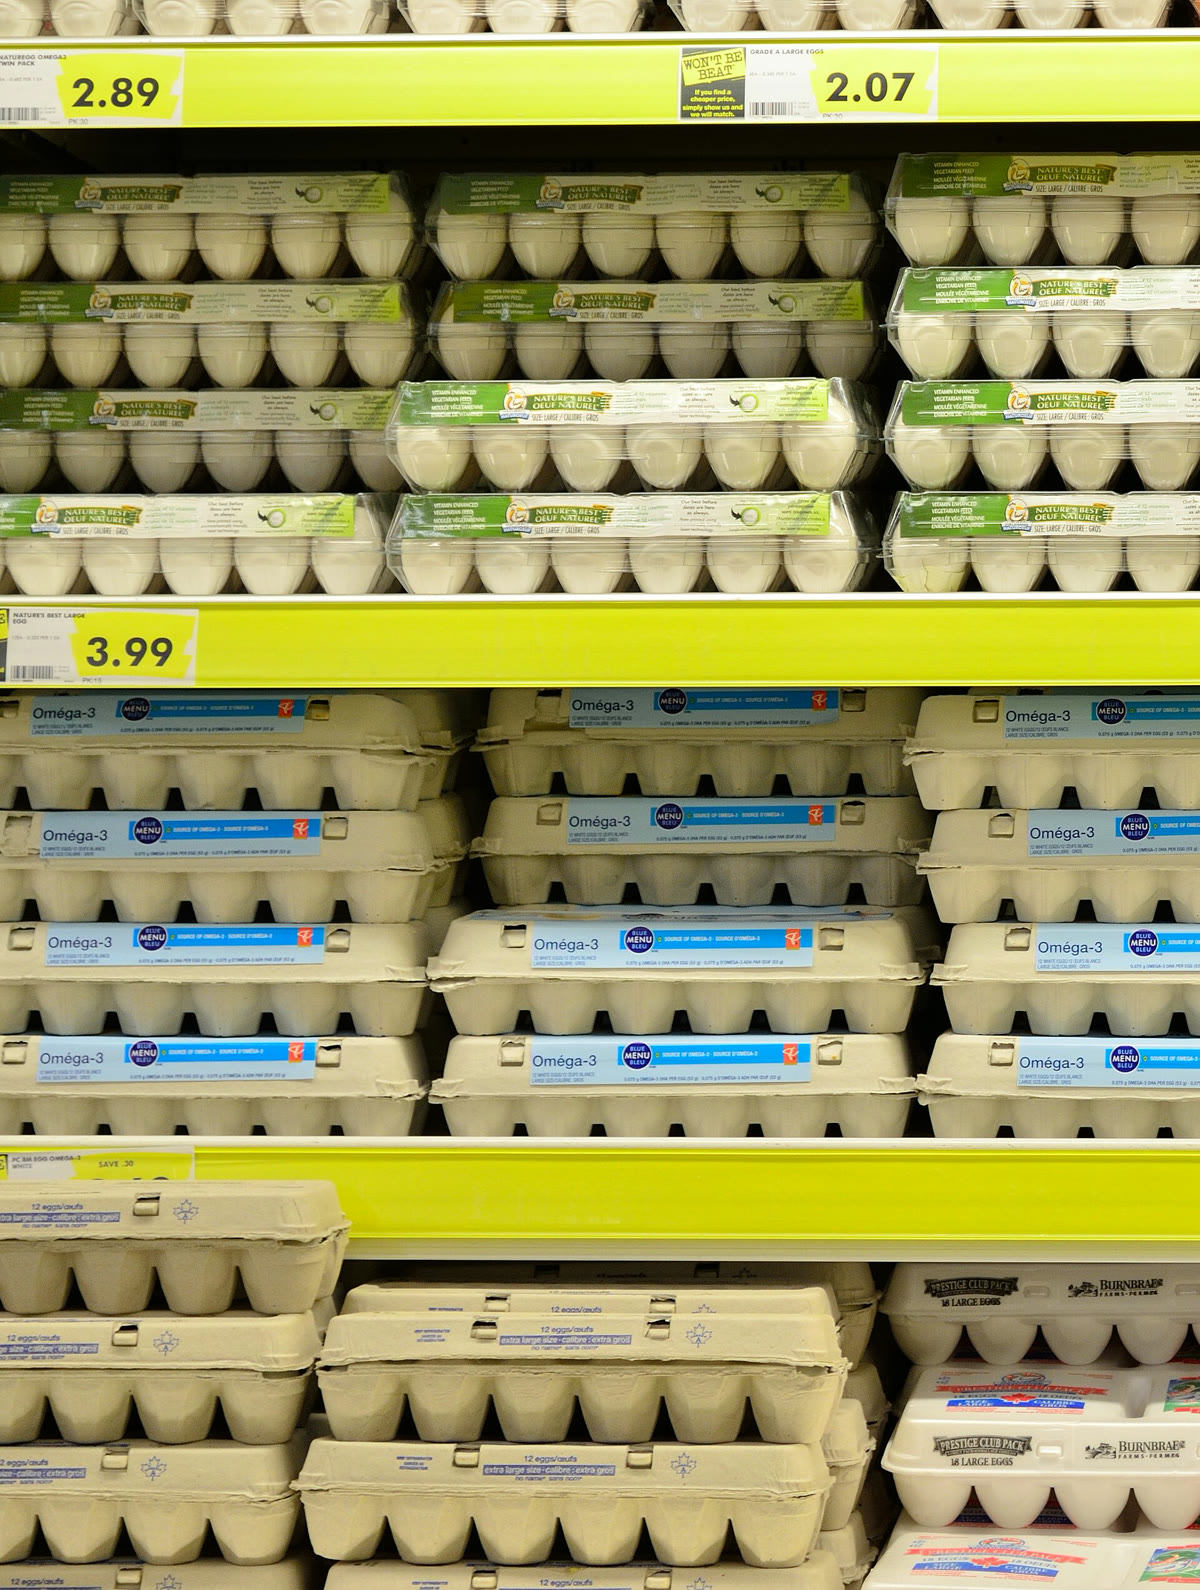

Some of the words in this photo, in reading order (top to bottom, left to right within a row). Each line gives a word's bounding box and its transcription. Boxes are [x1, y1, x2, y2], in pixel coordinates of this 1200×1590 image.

[683, 52, 722, 70] WON'T
[725, 51, 743, 63] BE
[698, 65, 733, 80] BEAT
[72, 77, 160, 108] 2.89
[700, 89, 712, 97] you
[825, 72, 915, 102] 2.07
[690, 96, 715, 104] cheaper
[716, 96, 736, 104] price,
[682, 104, 703, 112] simply
[1063, 174, 1101, 182] NATUREL
[86, 637, 173, 667] 3.99
[572, 699, 634, 713] Oméga-3
[1005, 709, 1071, 723] Oméga-3
[43, 829, 108, 844] Oméga-3
[48, 936, 113, 951] Oméga-3
[534, 938, 599, 952] Oméga-3
[1038, 941, 1103, 956] Oméga-3
[1130, 939, 1157, 947] MENU
[40, 1052, 104, 1066] Oméga-3
[940, 1437, 979, 1451] PRESTIGE
[979, 1437, 1002, 1449] CLUB
[1002, 1438, 1025, 1451] PACK
[1118, 1440, 1180, 1453] BURNBRAE
[534, 1455, 577, 1464] eggs/œufs
[951, 1458, 960, 1466] 18
[961, 1457, 990, 1466] LARGE
[991, 1457, 1013, 1466] EGGS
[21, 1578, 64, 1587] eggs/œufs
